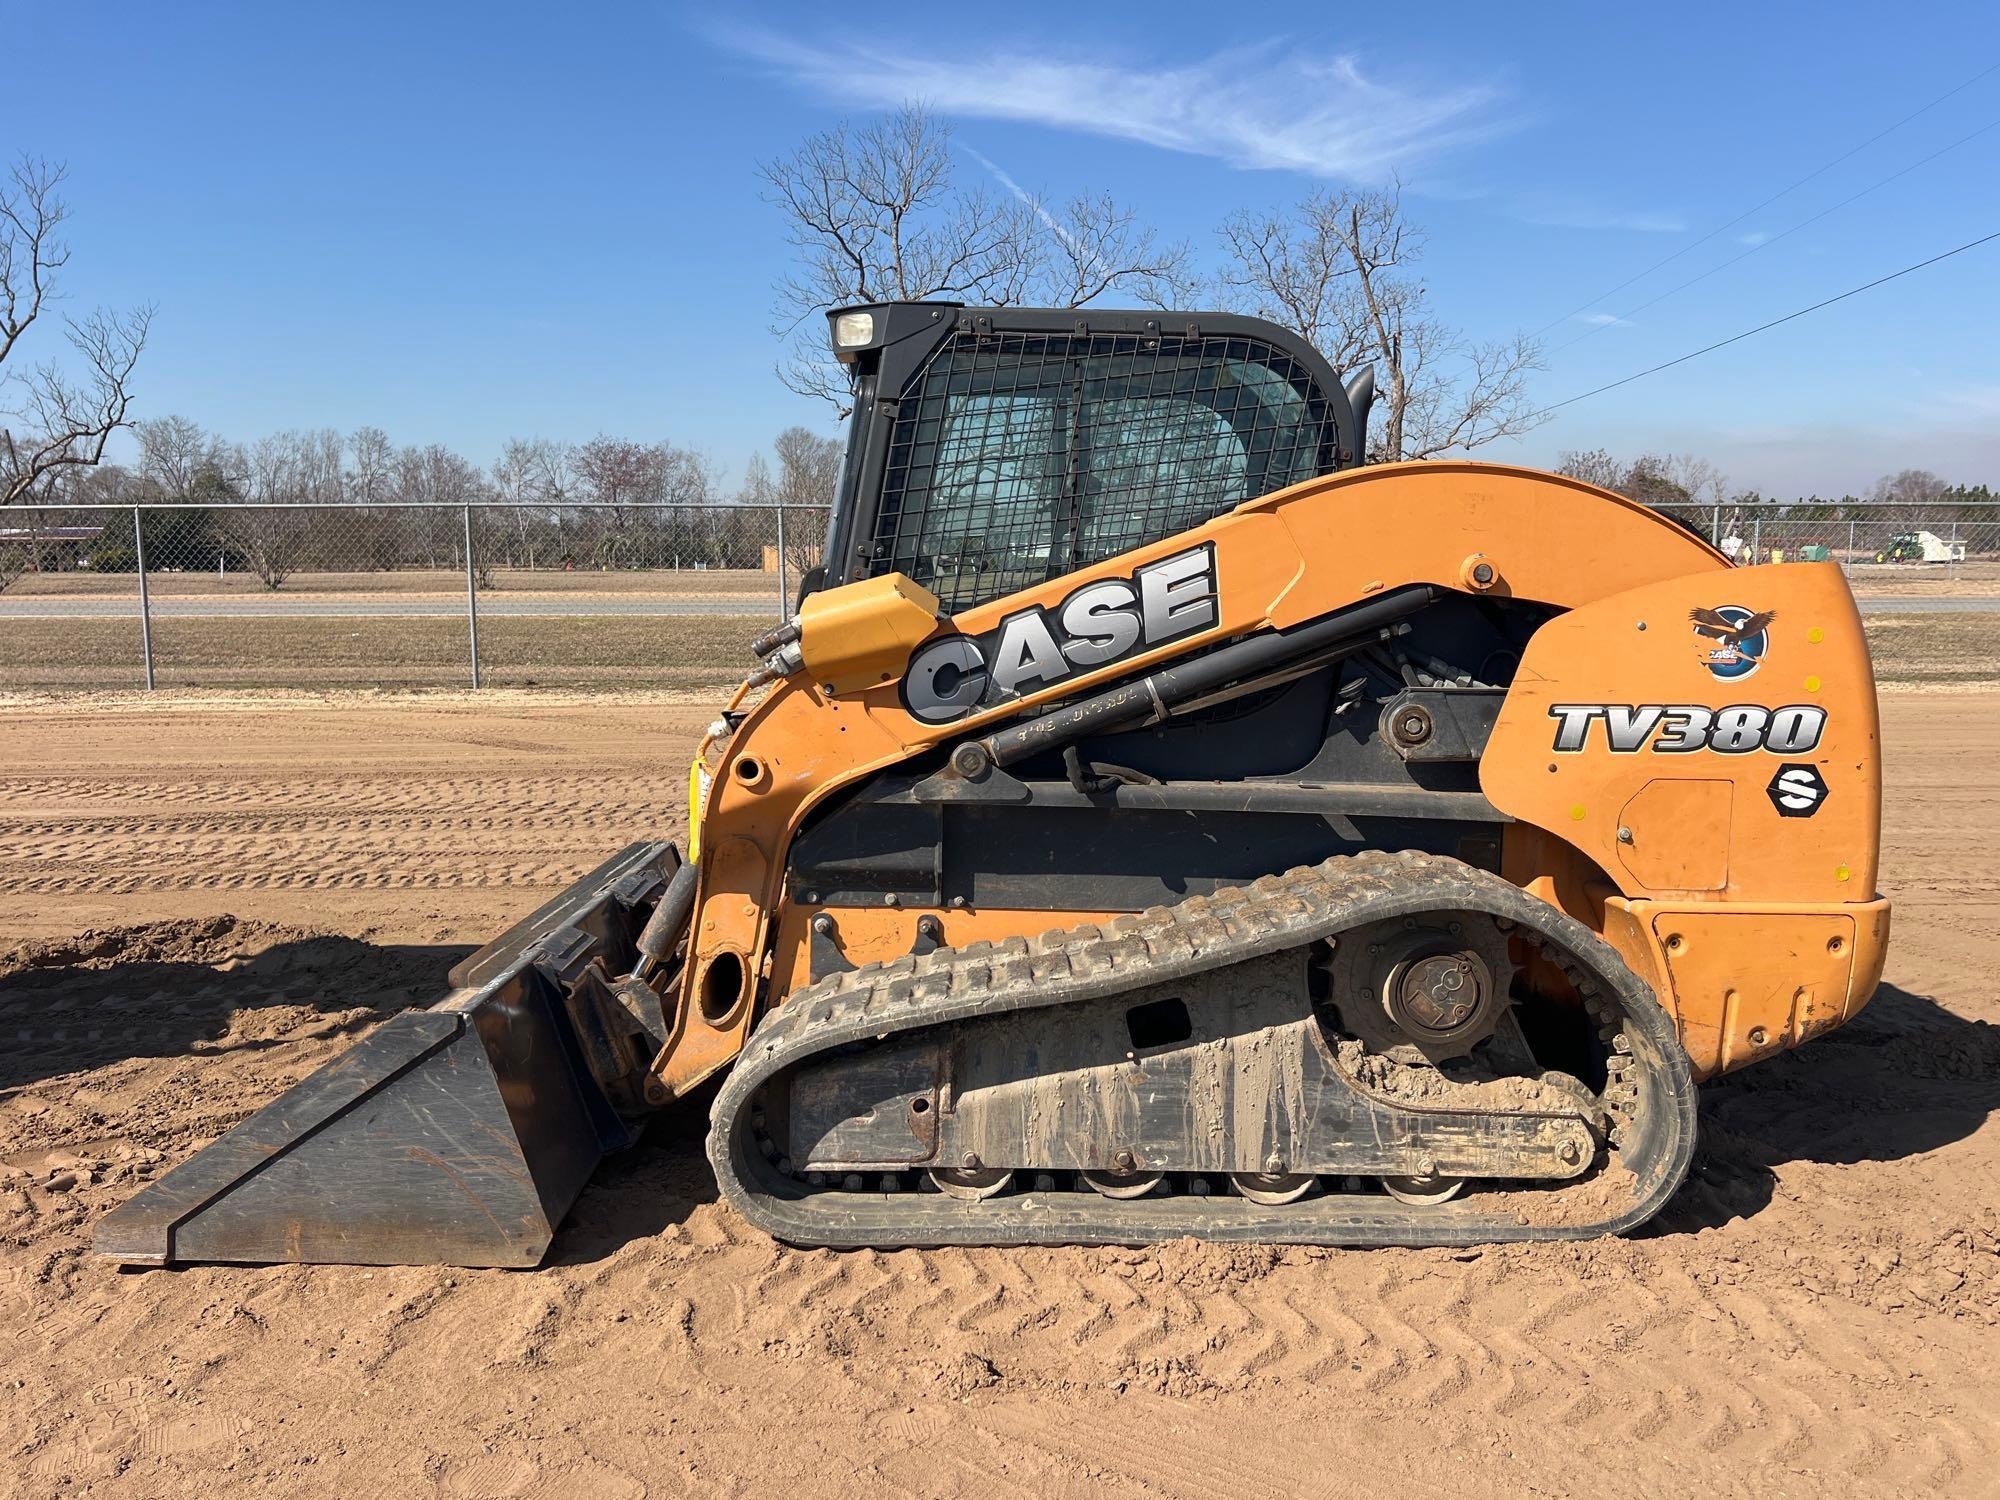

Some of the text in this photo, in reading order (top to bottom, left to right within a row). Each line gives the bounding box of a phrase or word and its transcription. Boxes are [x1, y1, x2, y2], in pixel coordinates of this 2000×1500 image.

[904, 546, 1216, 722] CASE
[1549, 704, 1827, 753] TV380
[1778, 769, 1818, 810] S
